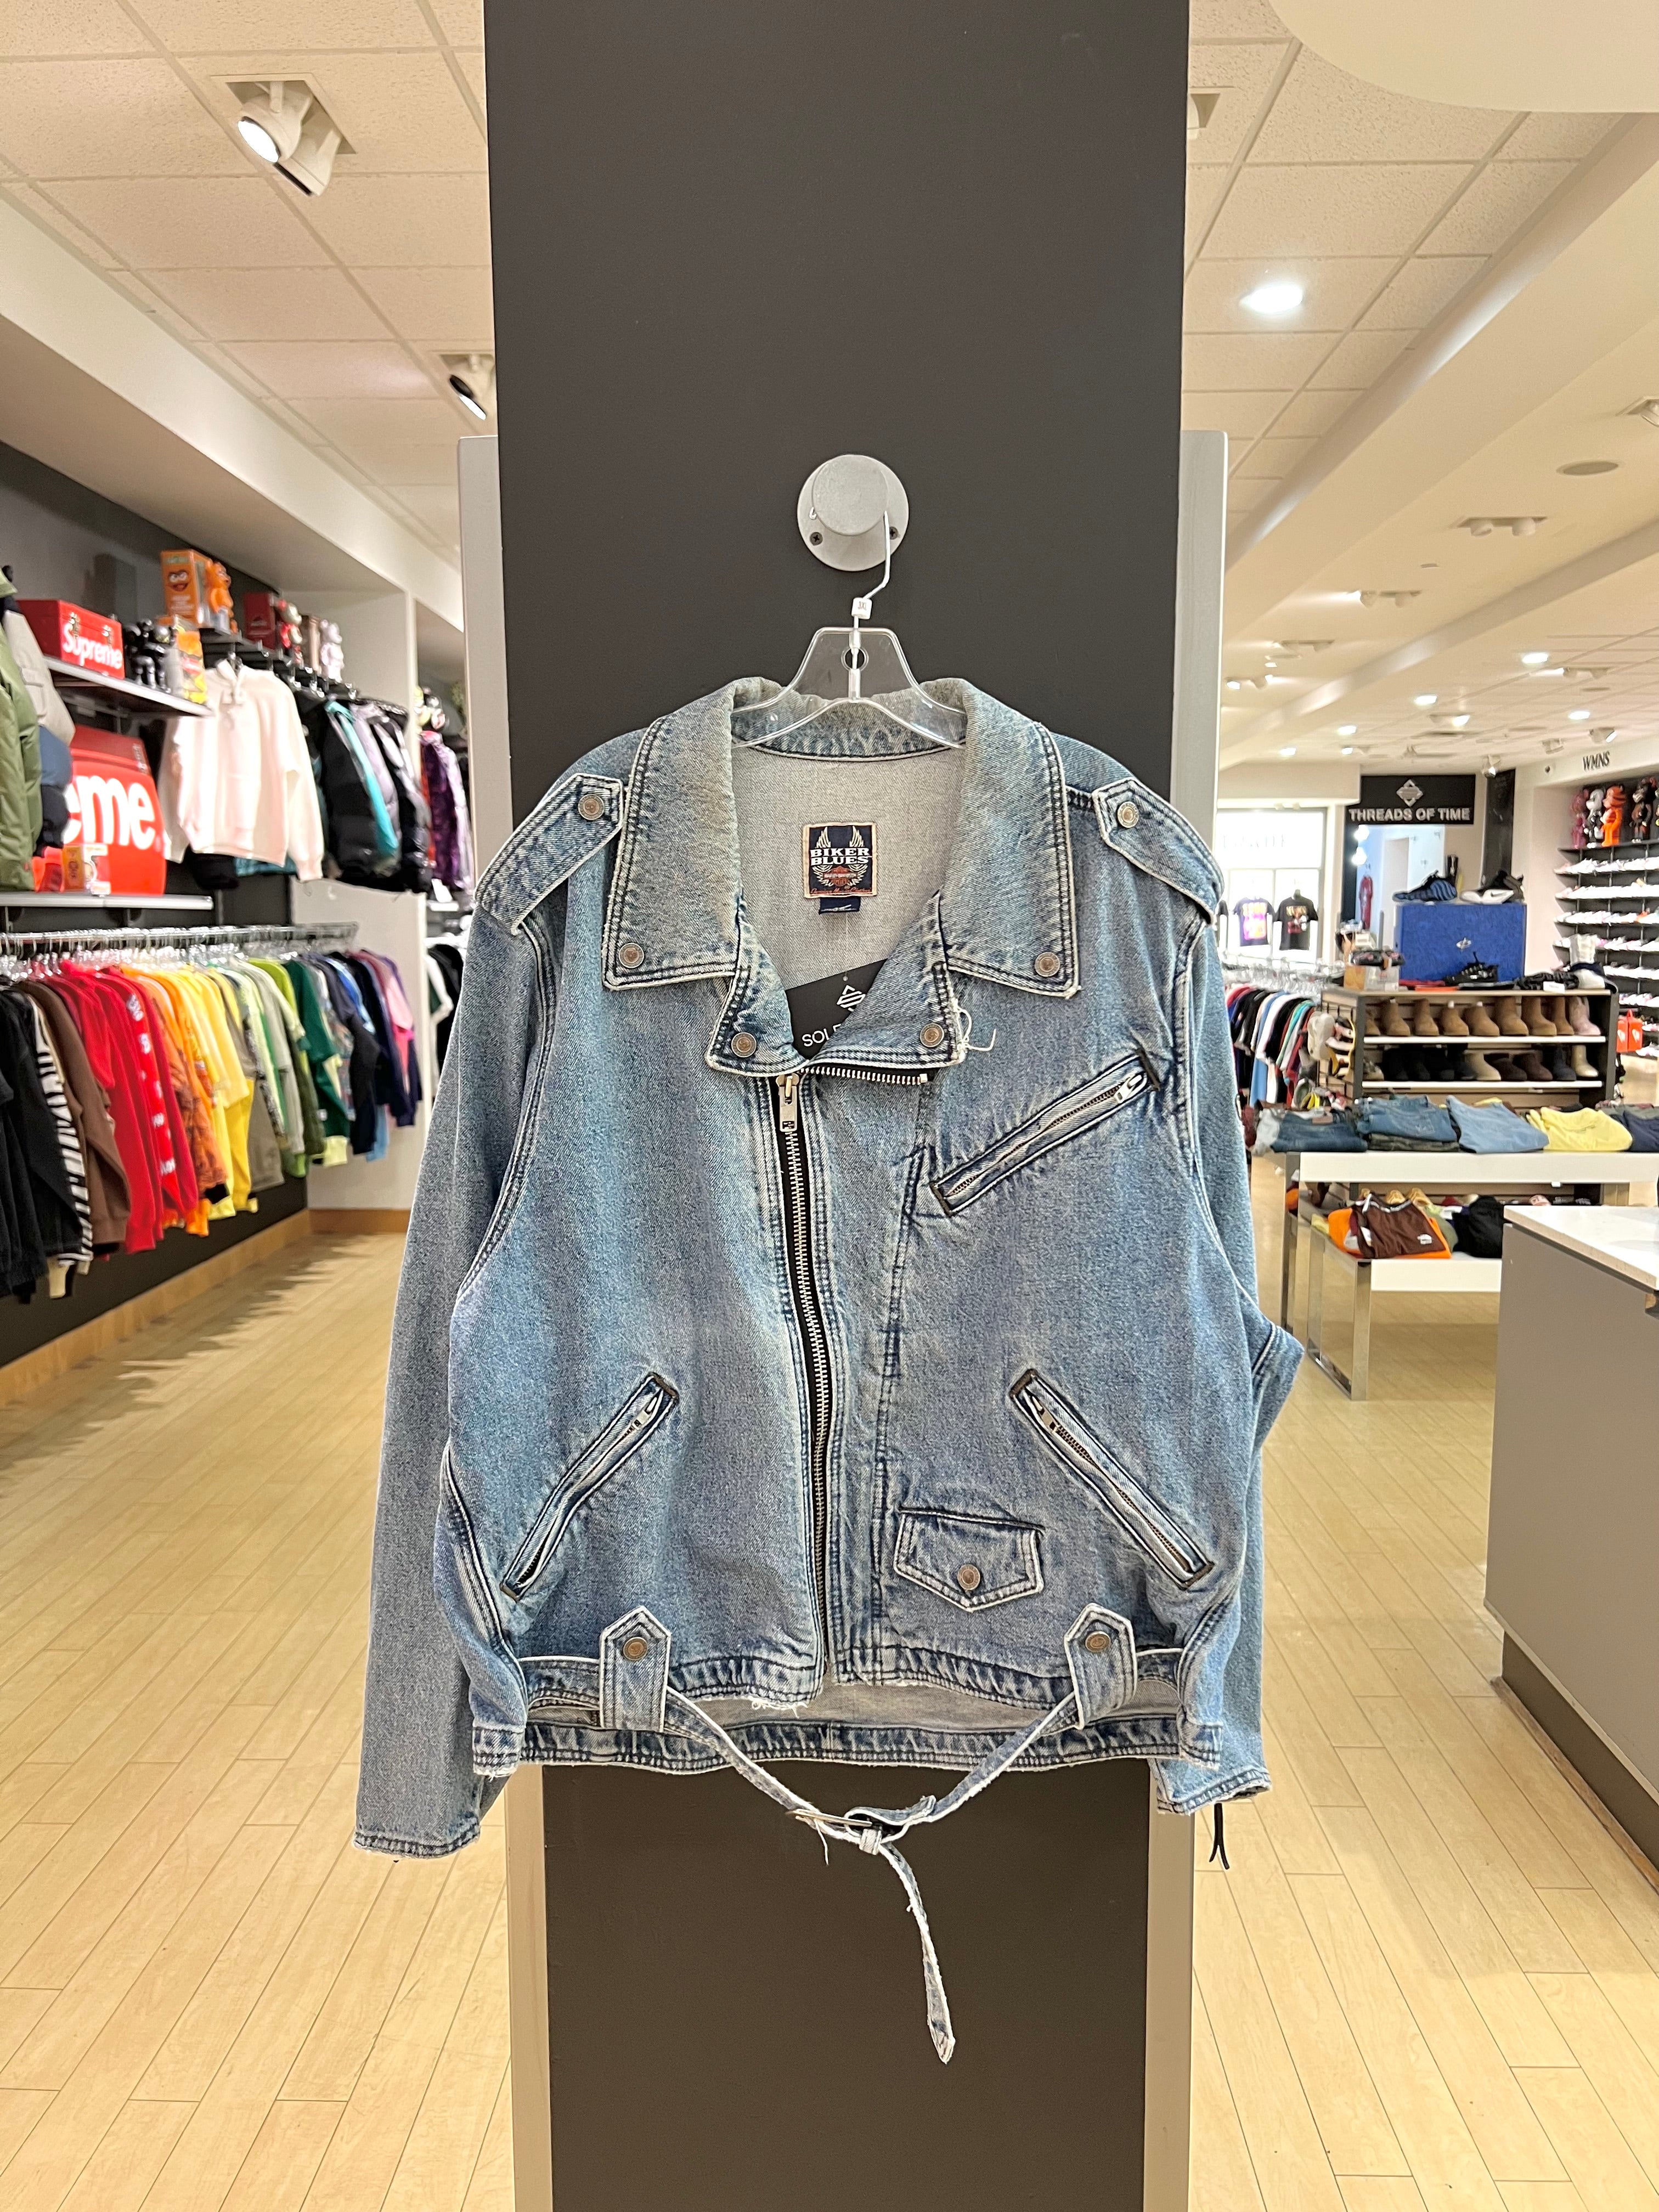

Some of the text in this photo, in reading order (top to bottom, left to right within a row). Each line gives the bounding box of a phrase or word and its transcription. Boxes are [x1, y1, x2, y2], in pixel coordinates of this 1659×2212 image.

[63, 623, 123, 669] Supreme
[1583, 751, 1610, 771] WMNS
[1348, 808, 1471, 821] THREADS OF TIME
[810, 848, 871, 857] BIKER
[811, 856, 869, 866] BLUES
